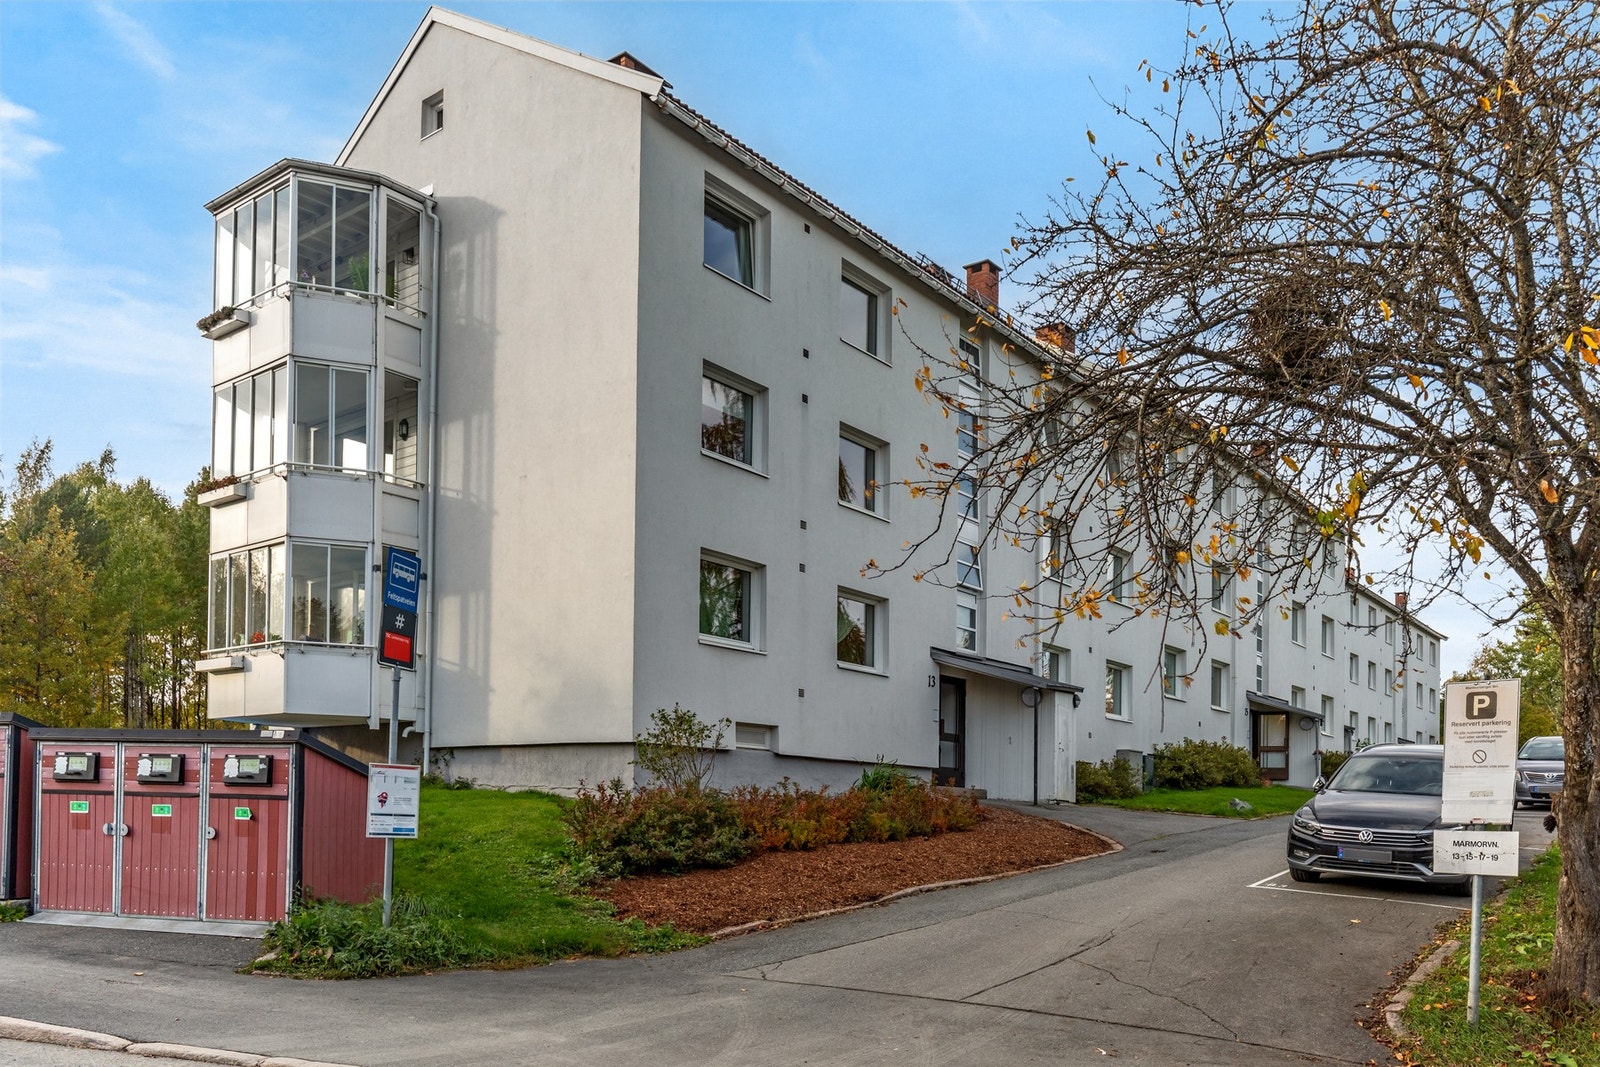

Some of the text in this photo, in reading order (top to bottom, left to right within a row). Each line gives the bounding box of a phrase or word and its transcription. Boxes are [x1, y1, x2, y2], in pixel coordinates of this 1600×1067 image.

[387, 591, 416, 607] Feltspatveien
[928, 674, 936, 687] 13
[1473, 695, 1490, 716] P
[1453, 840, 1499, 848] MARMORVN.
